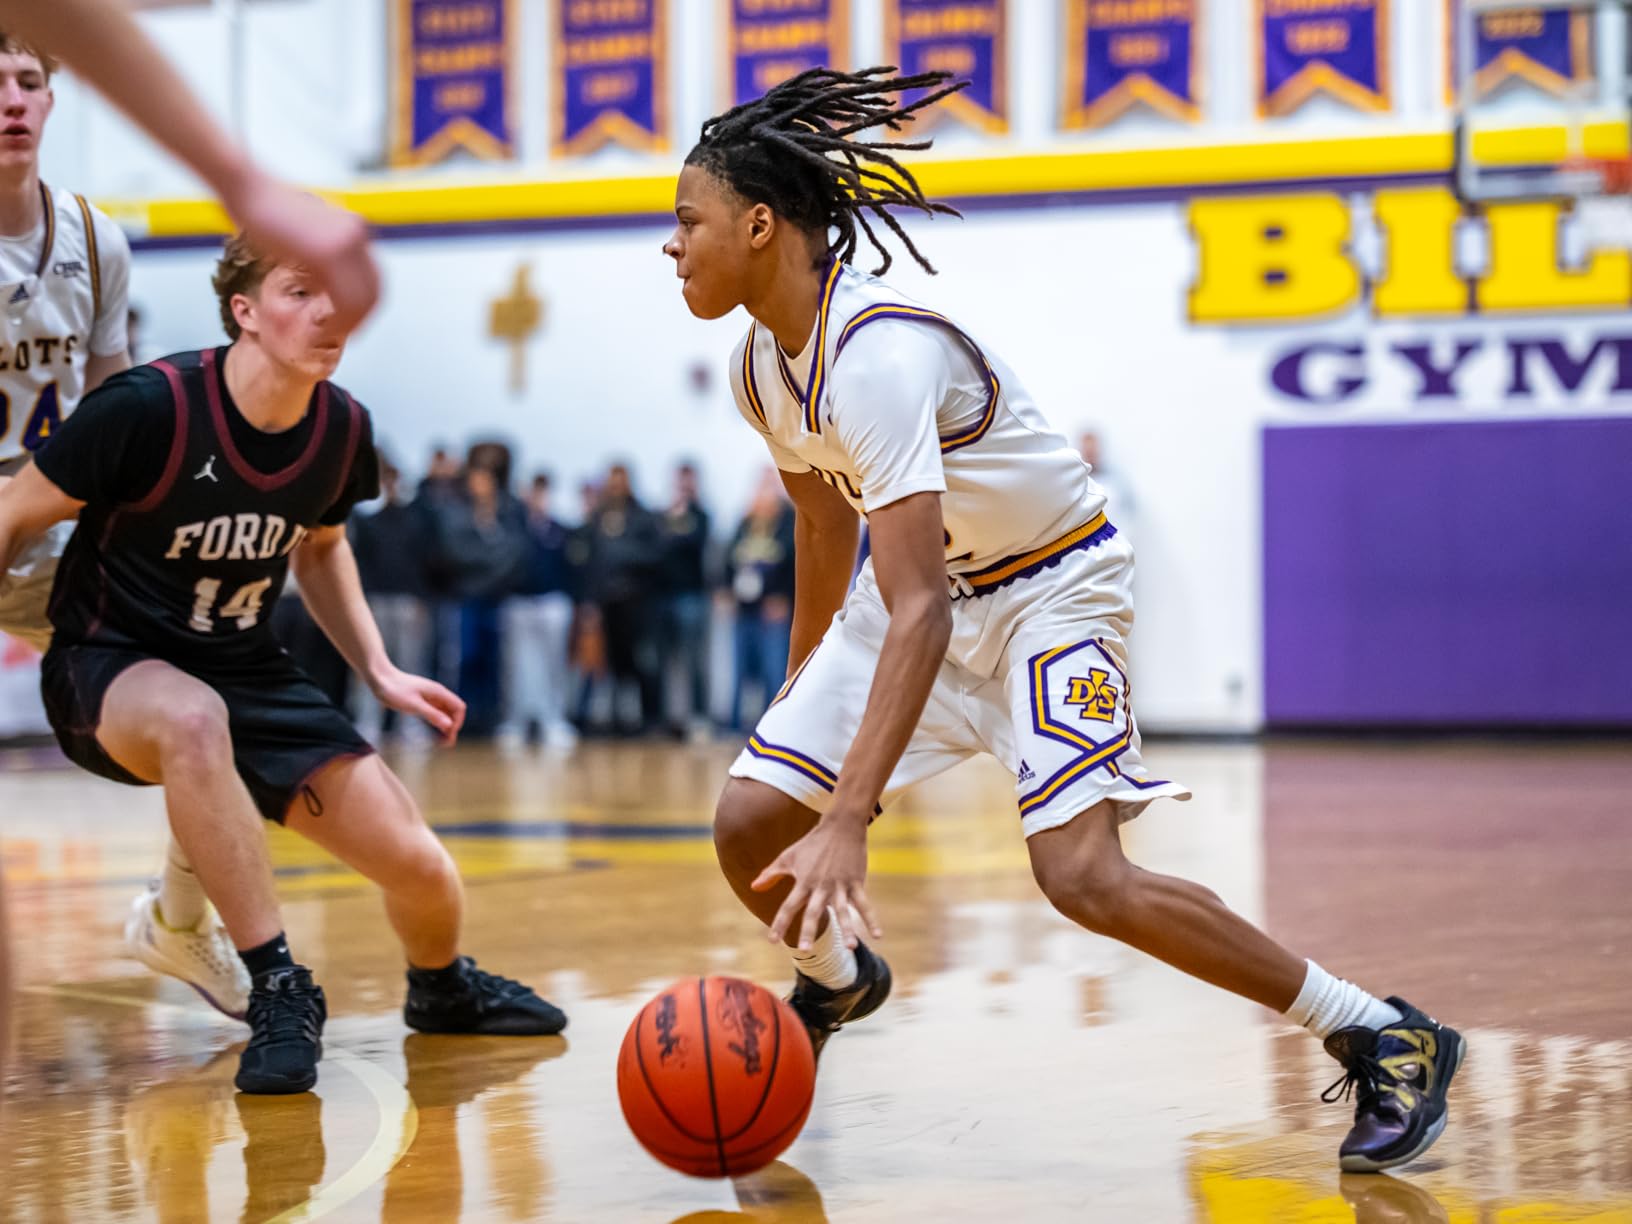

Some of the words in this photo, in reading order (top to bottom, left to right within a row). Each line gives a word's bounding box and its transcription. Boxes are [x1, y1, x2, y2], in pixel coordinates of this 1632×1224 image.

[1269, 338, 1632, 402] GYM
[0, 379, 62, 452] 4
[188, 576, 272, 632] 14
